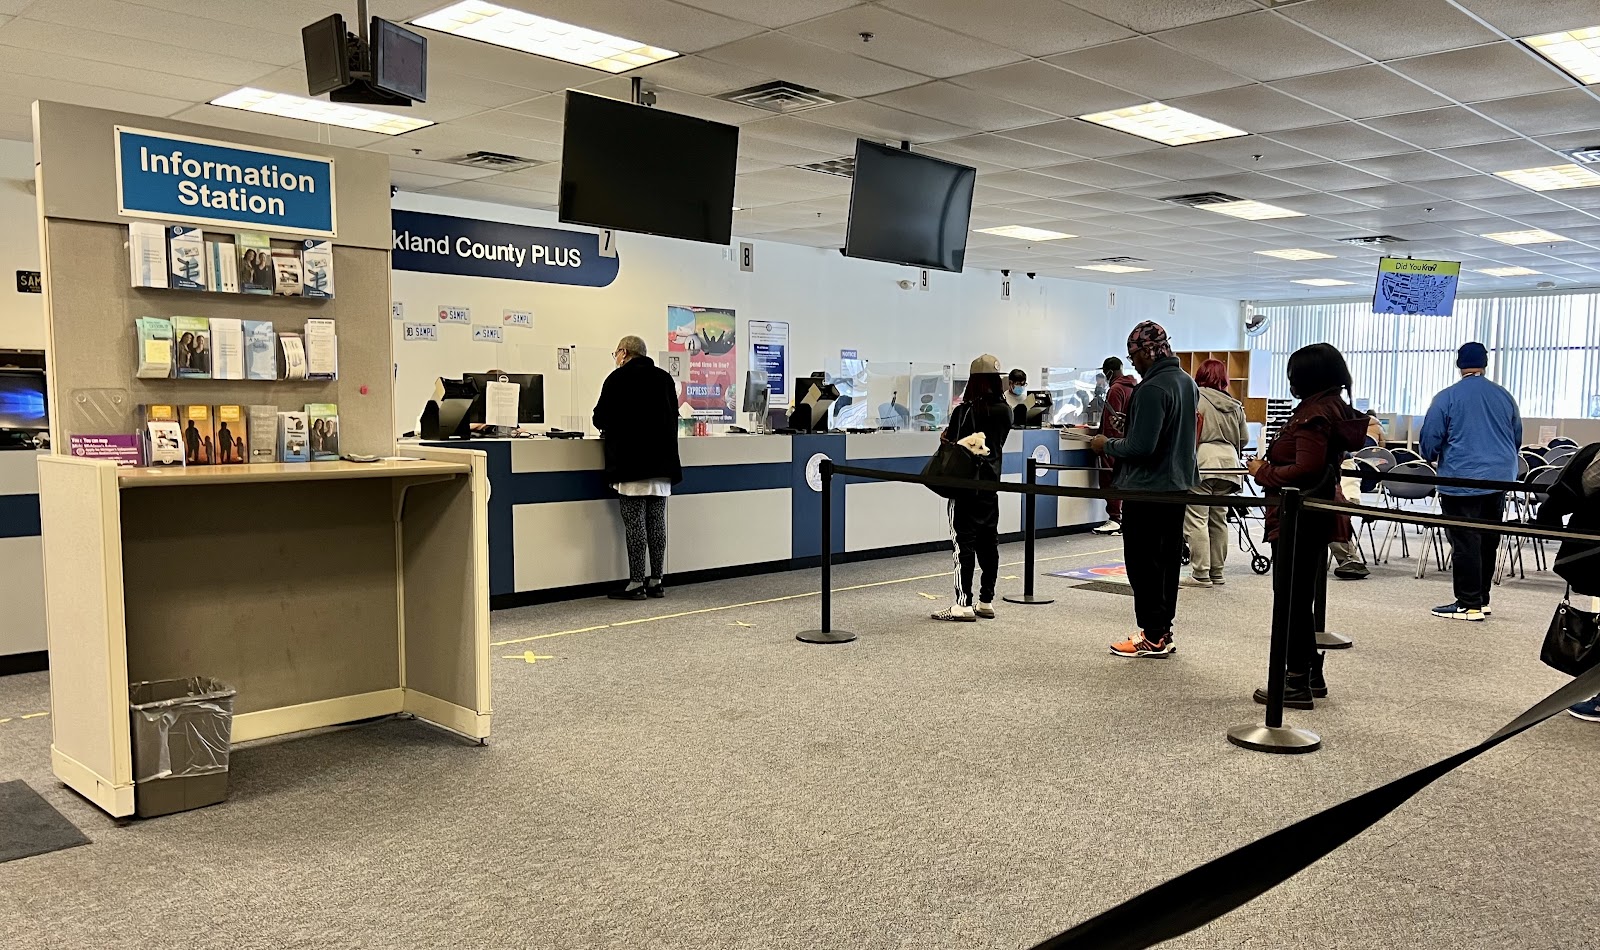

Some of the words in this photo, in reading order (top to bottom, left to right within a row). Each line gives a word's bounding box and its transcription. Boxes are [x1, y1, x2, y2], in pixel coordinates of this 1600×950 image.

[140, 146, 315, 193] Information
[177, 180, 285, 216] Station
[604, 230, 611, 251] 7
[455, 237, 526, 268] County
[531, 244, 582, 268] PLUS
[744, 247, 750, 267] 8
[1396, 262, 1407, 270] Did
[1409, 263, 1421, 271] You
[922, 270, 927, 287] 9
[1002, 281, 1010, 297] 10
[1110, 292, 1115, 306] 11
[1169, 298, 1175, 312] 12
[415, 327, 434, 337] SAMPL
